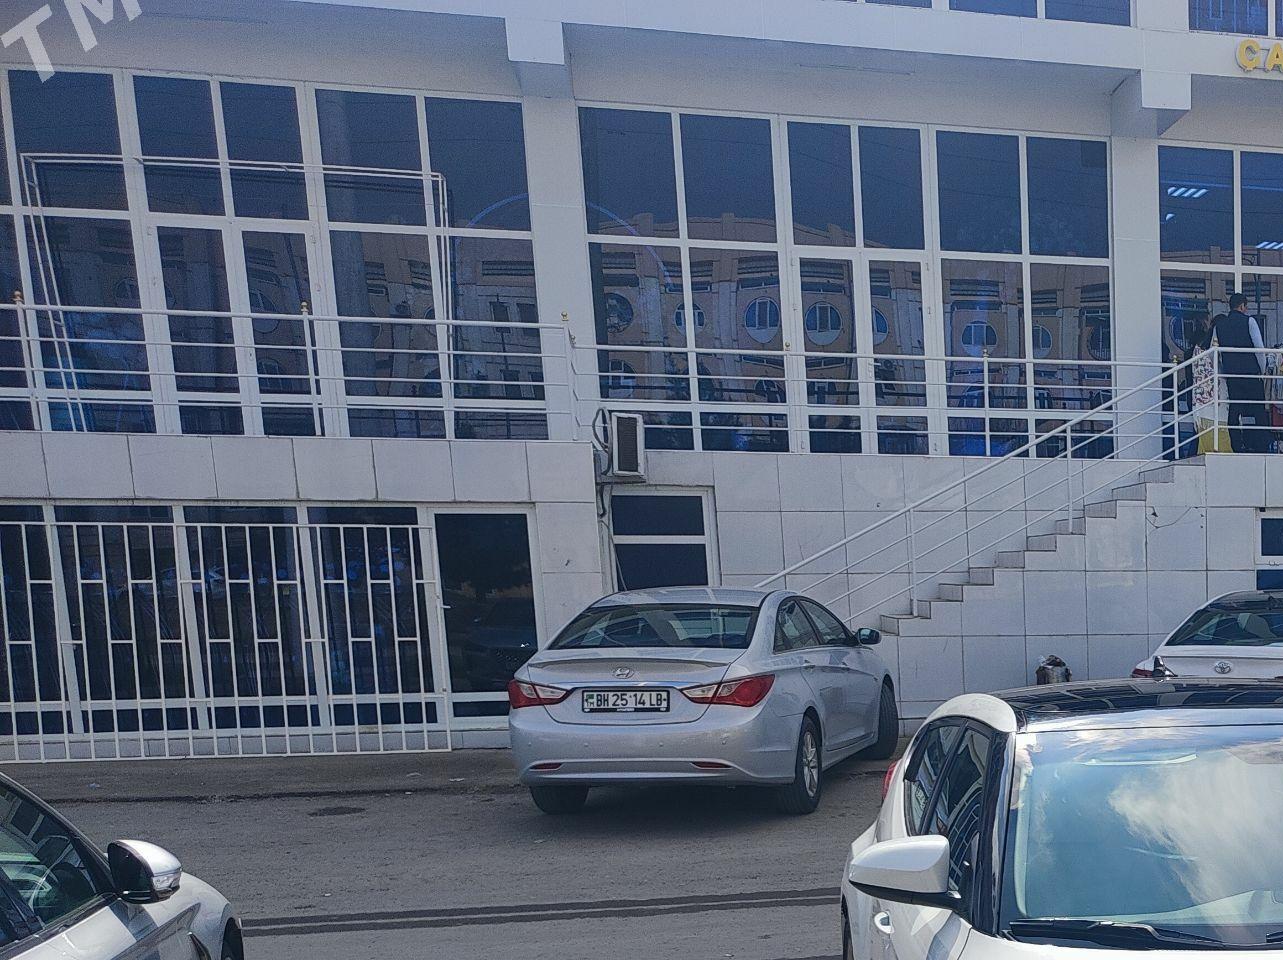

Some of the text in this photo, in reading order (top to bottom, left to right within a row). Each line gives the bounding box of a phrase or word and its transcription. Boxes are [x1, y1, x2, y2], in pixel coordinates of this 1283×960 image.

[596, 693, 663, 707] BH 25 14 LB
